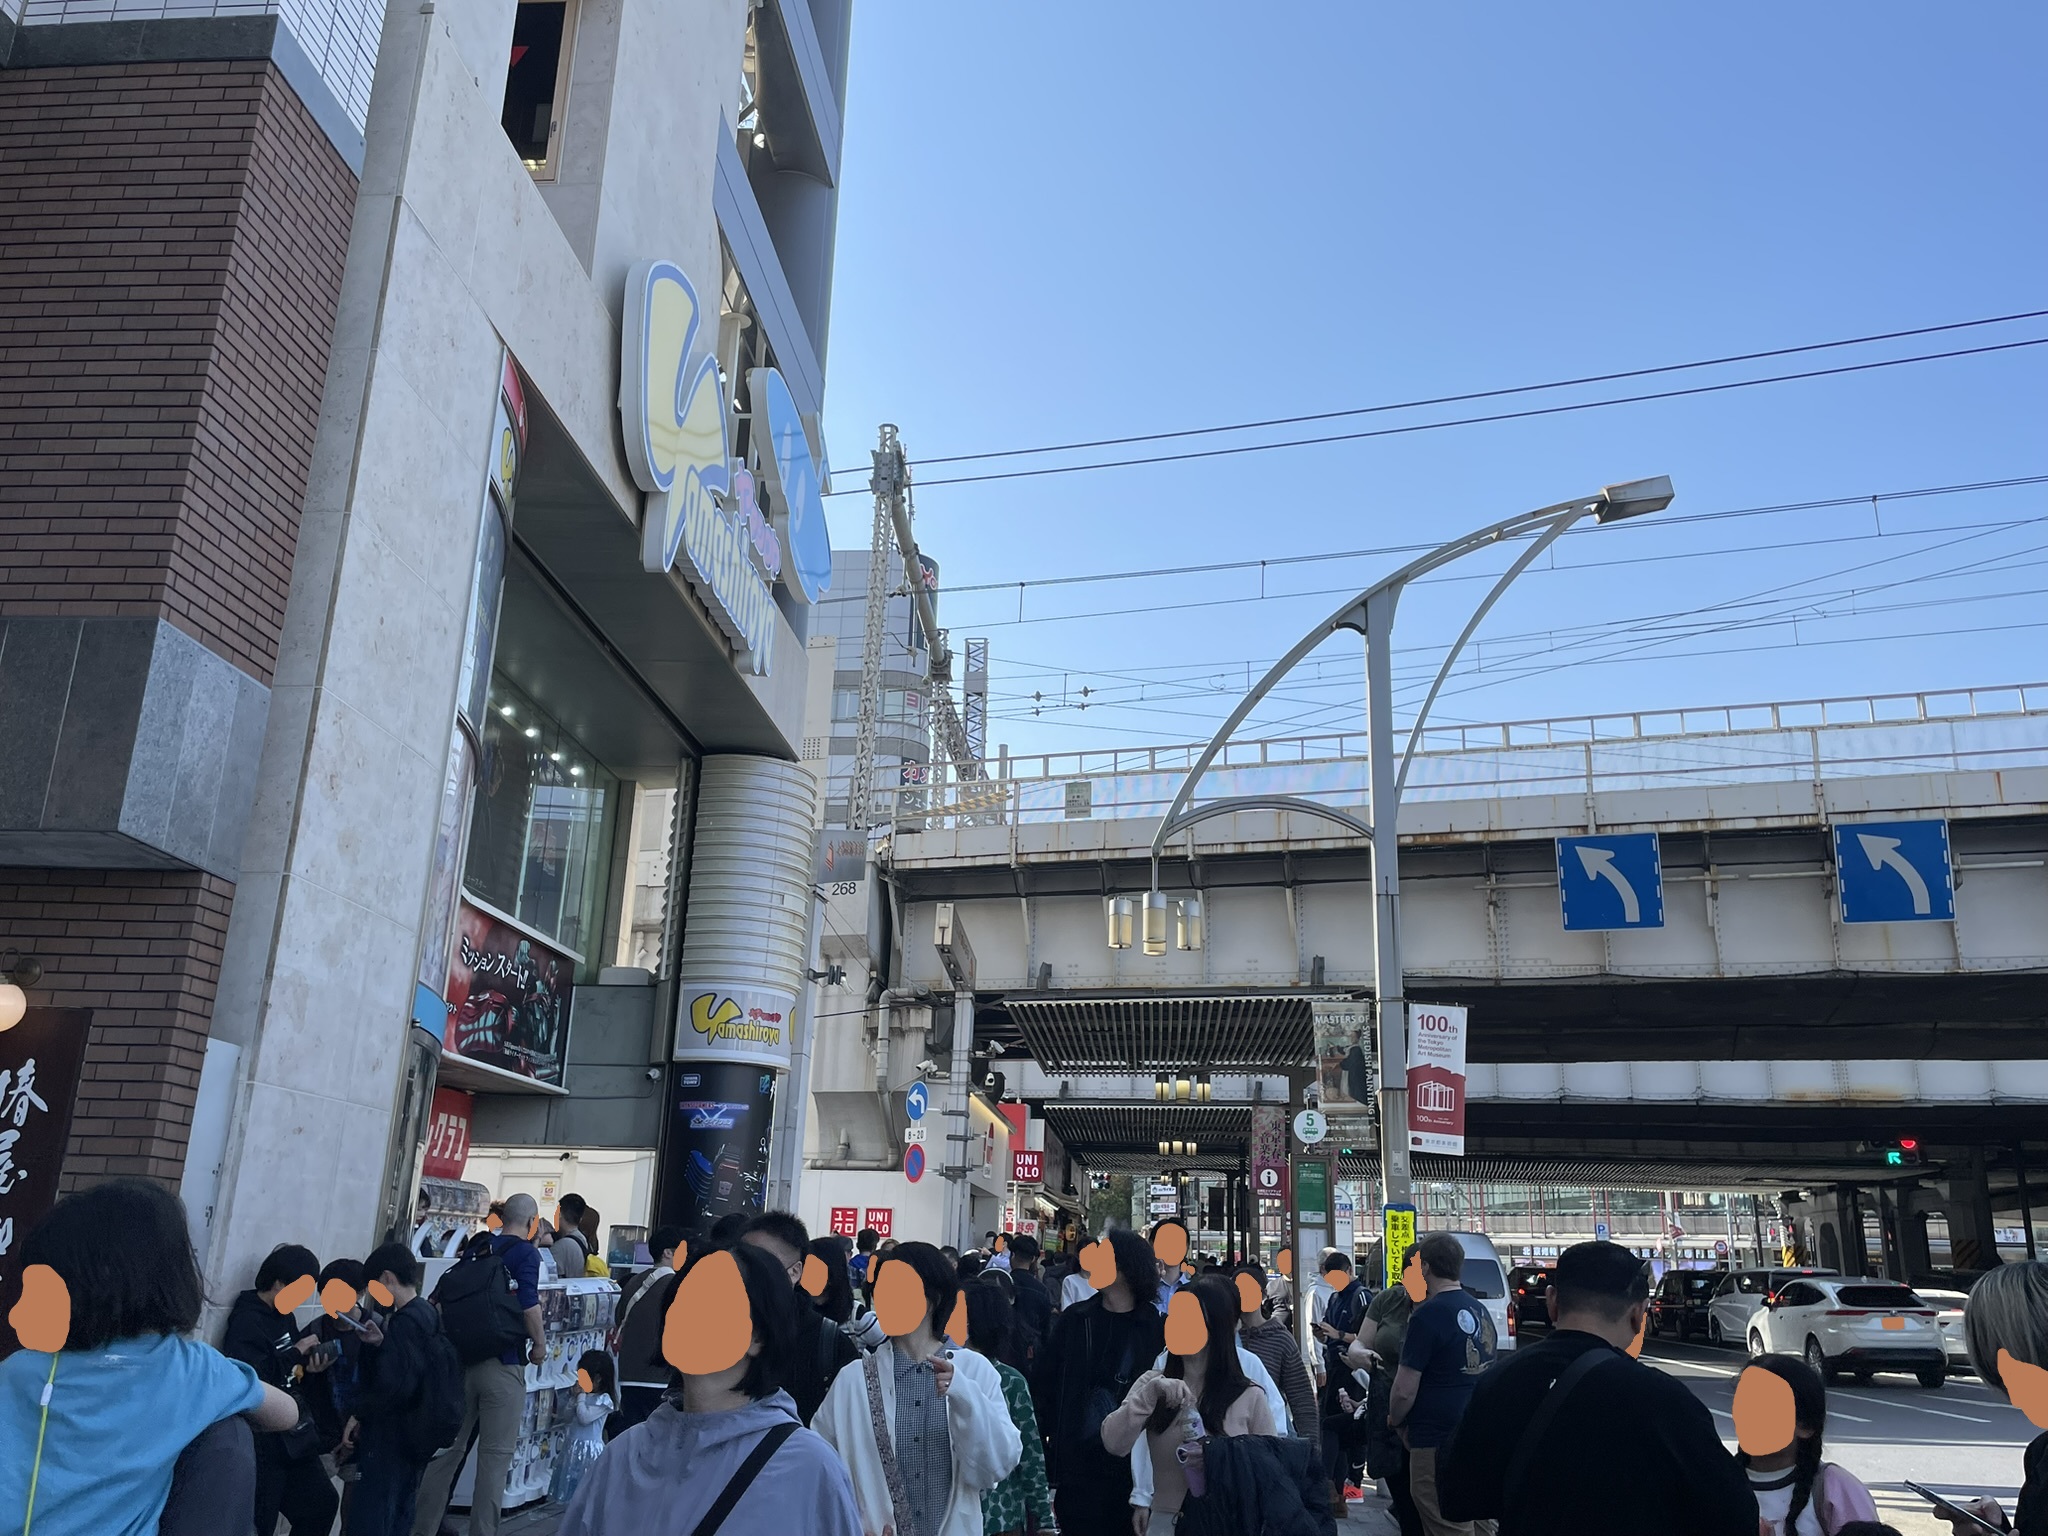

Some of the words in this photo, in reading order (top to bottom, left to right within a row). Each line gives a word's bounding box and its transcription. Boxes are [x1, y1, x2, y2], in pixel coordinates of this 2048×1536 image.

[832, 882, 856, 895] 268
[461, 937, 495, 972] ミッション
[690, 992, 780, 1046] Yamashiroya
[1315, 1015, 1356, 1024] MASTERS
[1417, 1014, 1458, 1033] 100th
[1362, 1025, 1372, 1067] SWEDISH
[1366, 1069, 1375, 1115] PAINTING
[1306, 1113, 1315, 1126] 5
[908, 1129, 924, 1140] 8-20
[1016, 1154, 1038, 1165] UNI
[1016, 1166, 1040, 1179] QLO
[834, 1210, 855, 1221] ユニ
[868, 1211, 888, 1222] UNI
[833, 1222, 854, 1233] クロ
[1598, 1224, 1606, 1234] P
